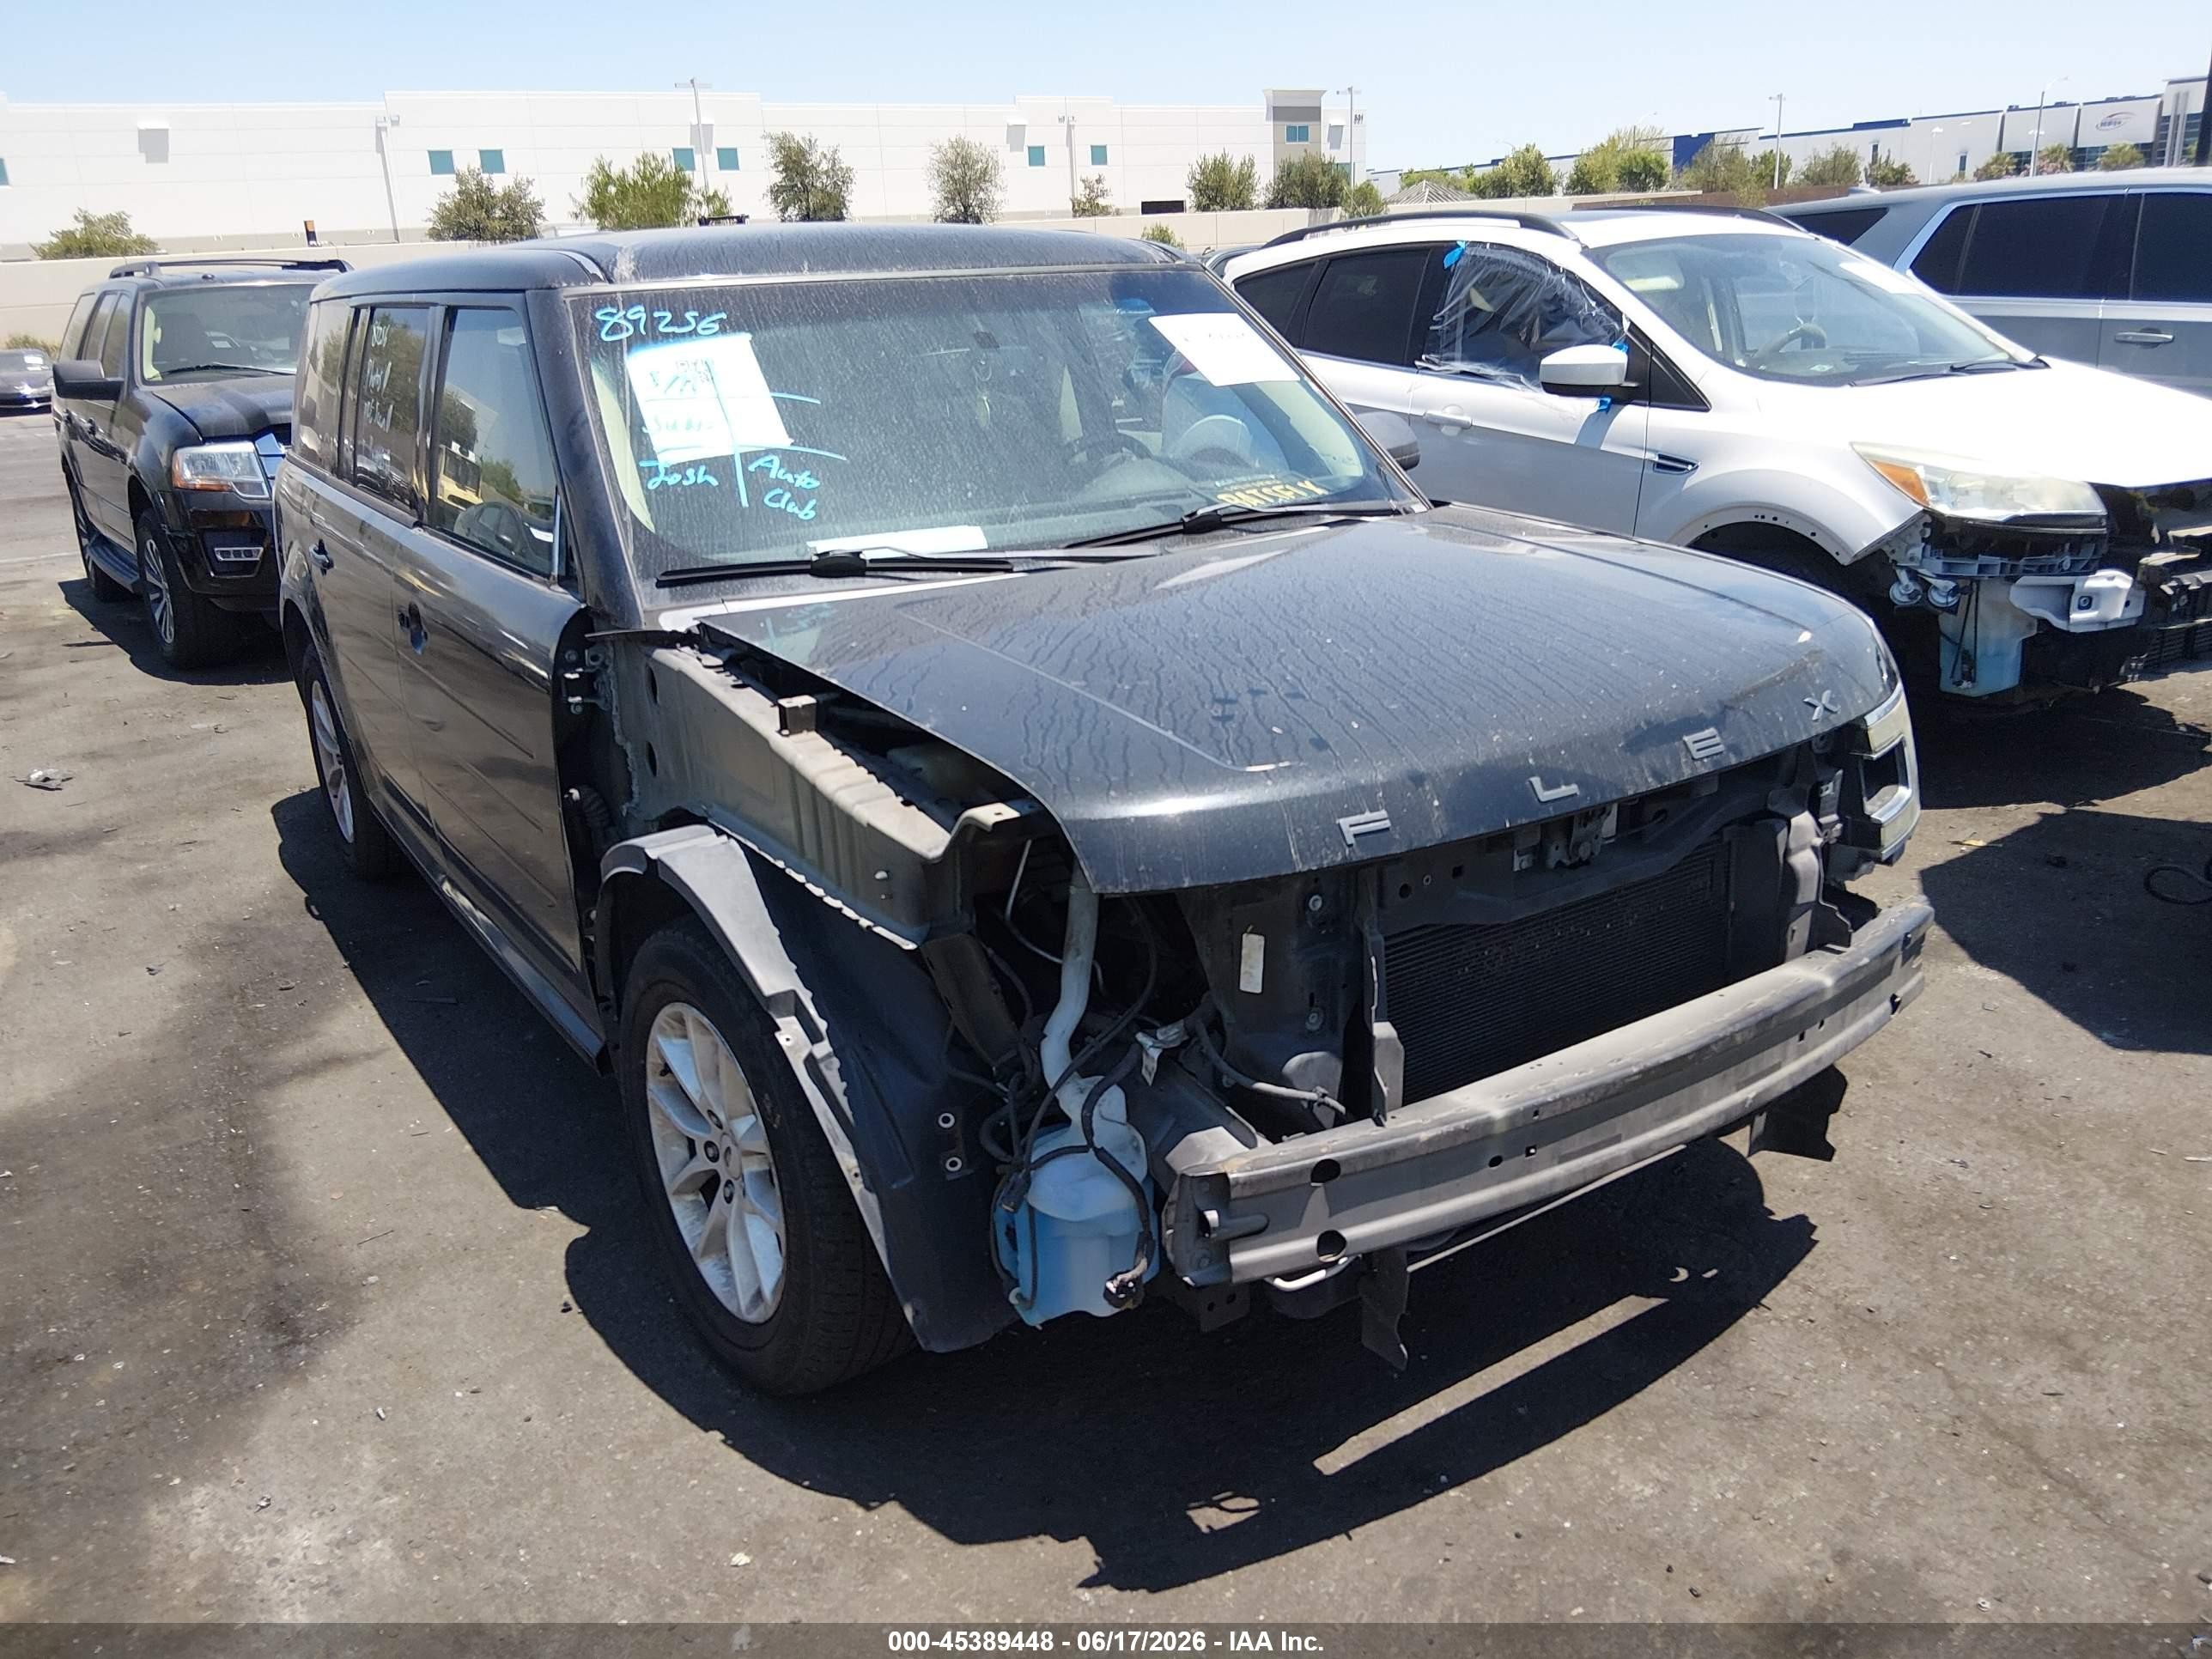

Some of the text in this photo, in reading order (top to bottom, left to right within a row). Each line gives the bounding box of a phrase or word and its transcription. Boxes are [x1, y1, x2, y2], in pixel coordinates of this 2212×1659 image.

[639, 459, 720, 491] Josh
[748, 454, 821, 490] Auto
[763, 488, 817, 520] Club
[1337, 689, 1841, 847] FLEX
